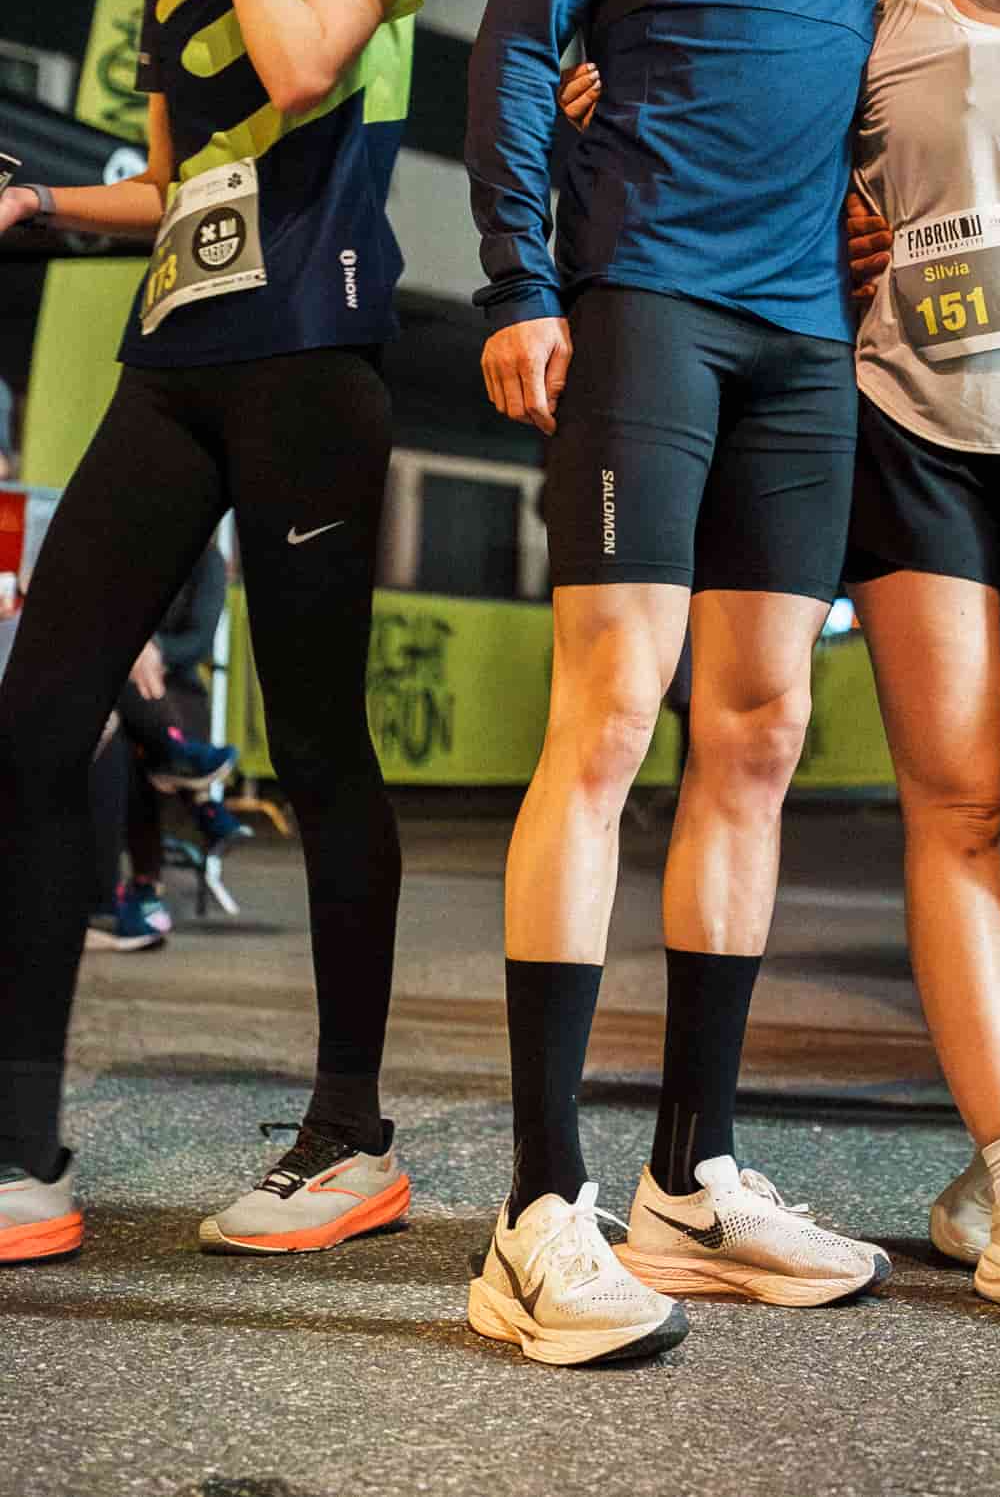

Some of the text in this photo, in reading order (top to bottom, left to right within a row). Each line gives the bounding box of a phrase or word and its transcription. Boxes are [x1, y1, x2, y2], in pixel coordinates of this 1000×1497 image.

[907, 217, 961, 251] FABRIK
[924, 262, 971, 283] Silvia
[916, 286, 989, 336] 151
[602, 469, 616, 555] SALOMON
